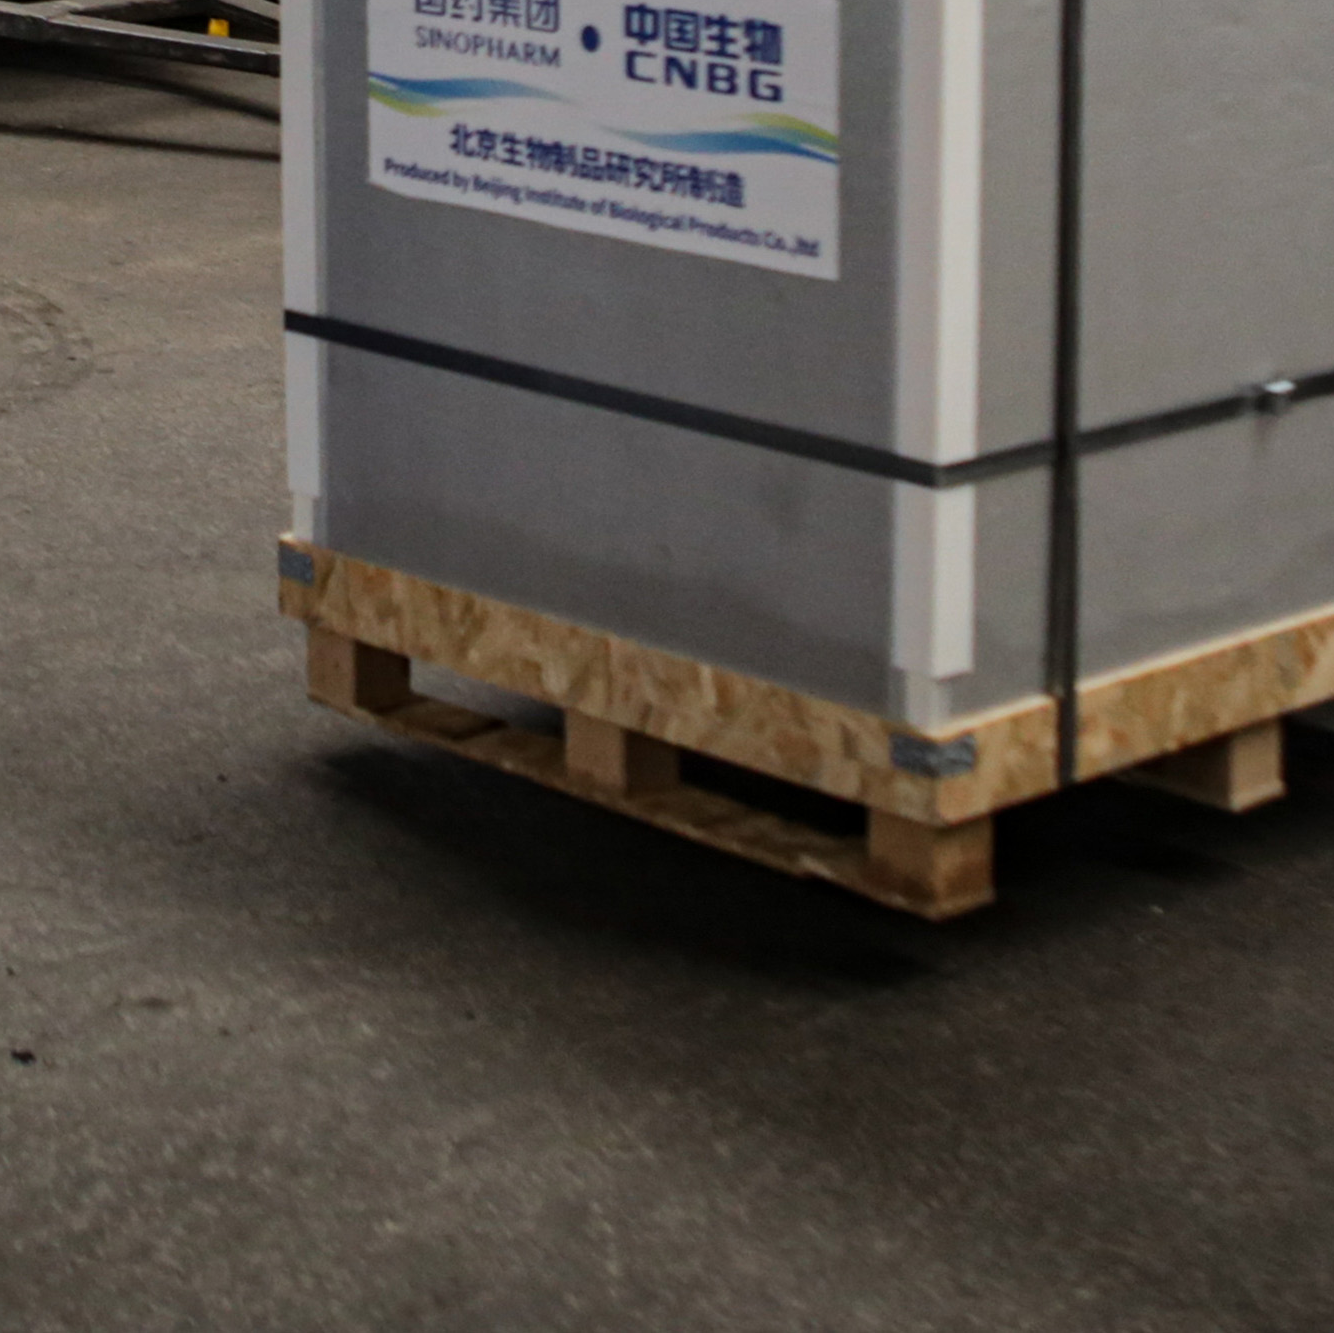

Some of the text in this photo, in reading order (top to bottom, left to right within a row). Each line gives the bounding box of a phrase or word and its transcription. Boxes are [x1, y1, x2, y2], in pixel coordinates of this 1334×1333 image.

[415, 25, 783, 103] SINOPHARM CNBG
[624, 3, 783, 64] 中国生物
[384, 156, 451, 186] Produced
[451, 169, 469, 194] by
[472, 174, 523, 206] Beijing
[525, 186, 587, 213] Institute
[590, 199, 608, 216] of
[609, 200, 684, 232] Biological
[687, 216, 759, 247] Products
[449, 122, 747, 209] 北京生物制品研究所制造
